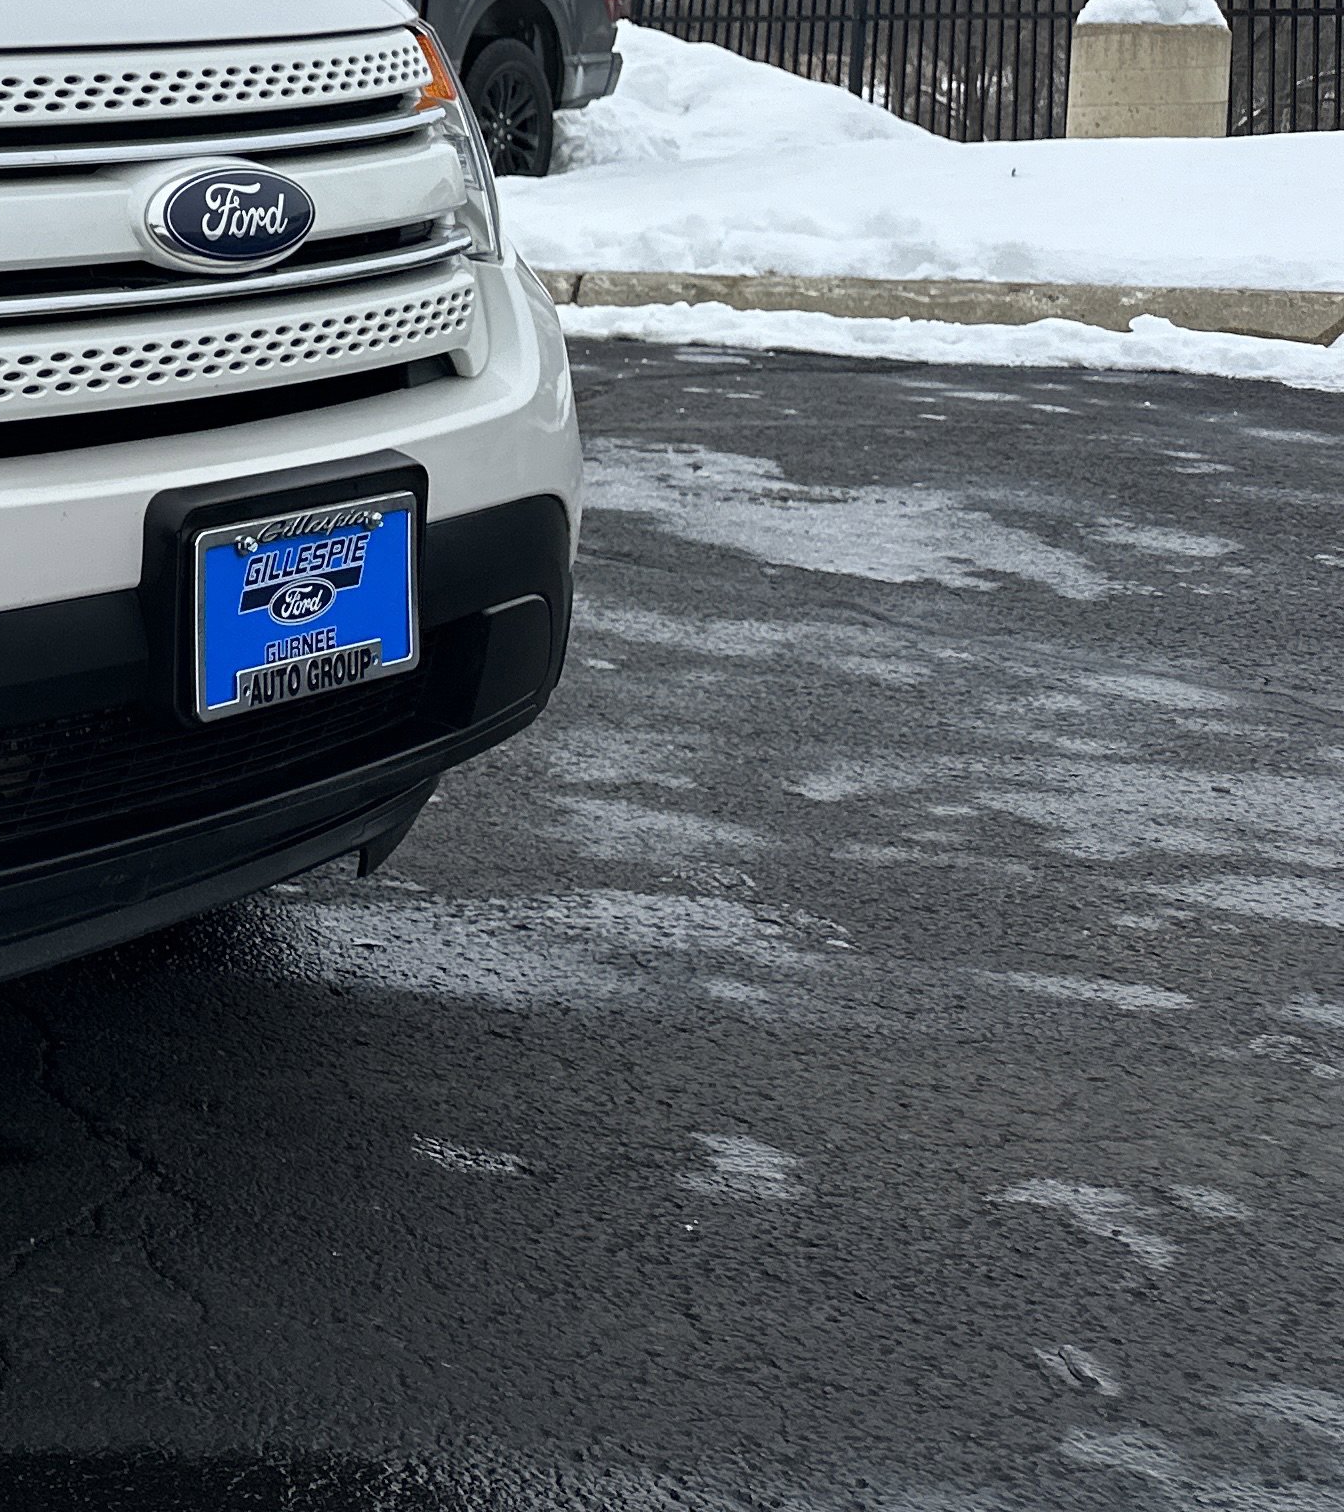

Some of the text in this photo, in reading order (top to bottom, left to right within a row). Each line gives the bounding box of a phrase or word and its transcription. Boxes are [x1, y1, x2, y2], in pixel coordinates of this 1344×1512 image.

[201, 182, 288, 241] Ford
[243, 532, 371, 588] GILLESPIE
[281, 586, 322, 618] Ford
[264, 625, 337, 665] GURNEE
[249, 647, 372, 707] AUTO GROUP
